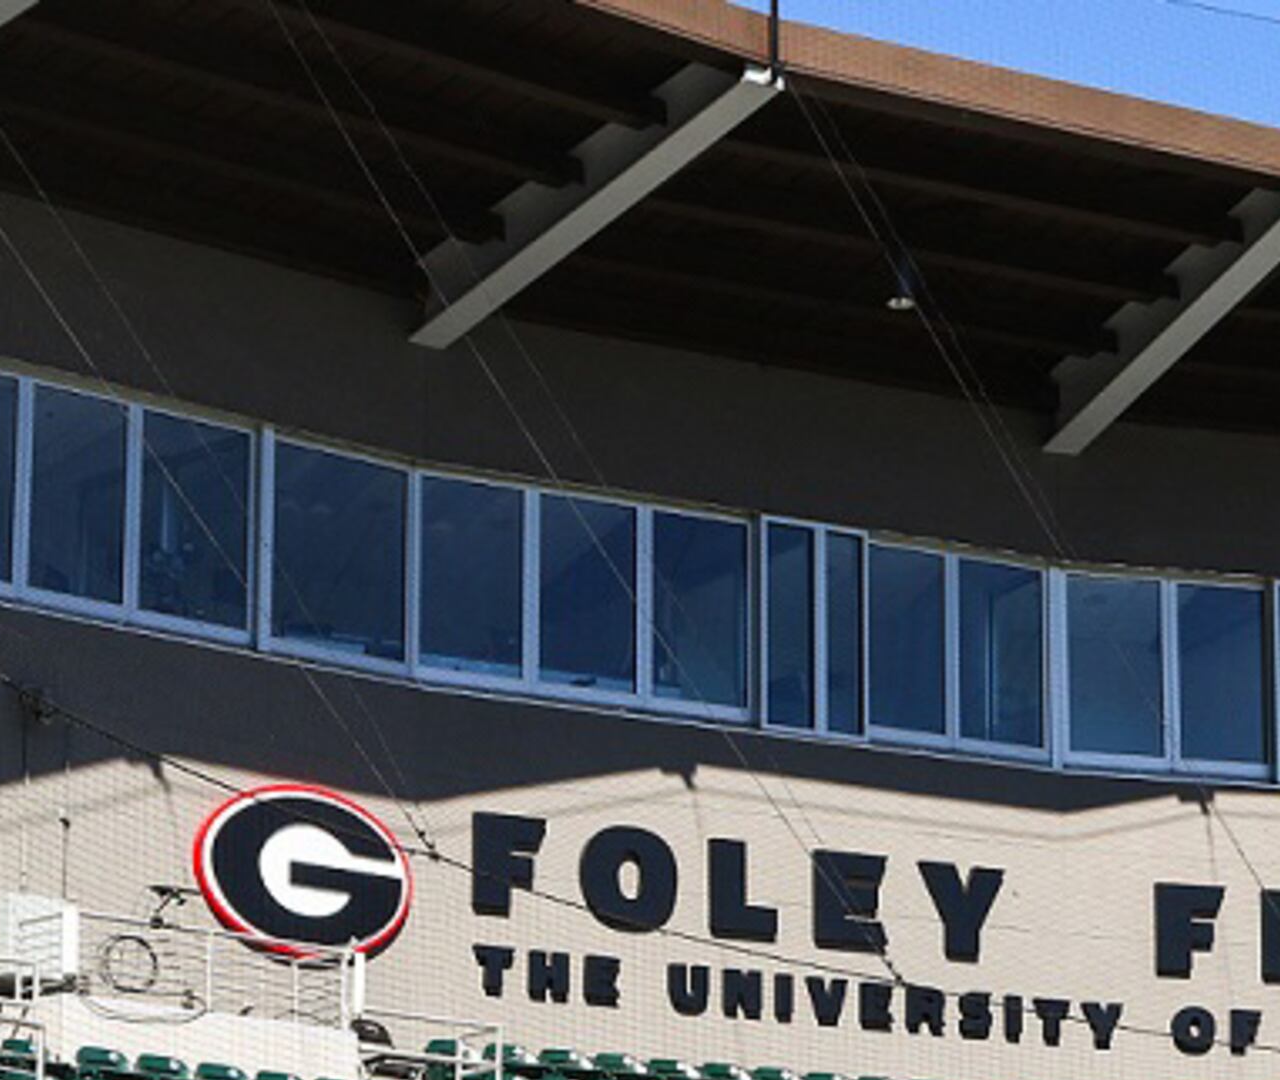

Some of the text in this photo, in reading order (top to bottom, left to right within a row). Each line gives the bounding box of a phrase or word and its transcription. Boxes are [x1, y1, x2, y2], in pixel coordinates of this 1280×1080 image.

[194, 784, 414, 965] G
[472, 811, 1006, 963] FOLEY
[472, 944, 621, 1008] THE
[666, 963, 1123, 1050] UNIVERSITY
[1170, 1006, 1262, 1055] OF
